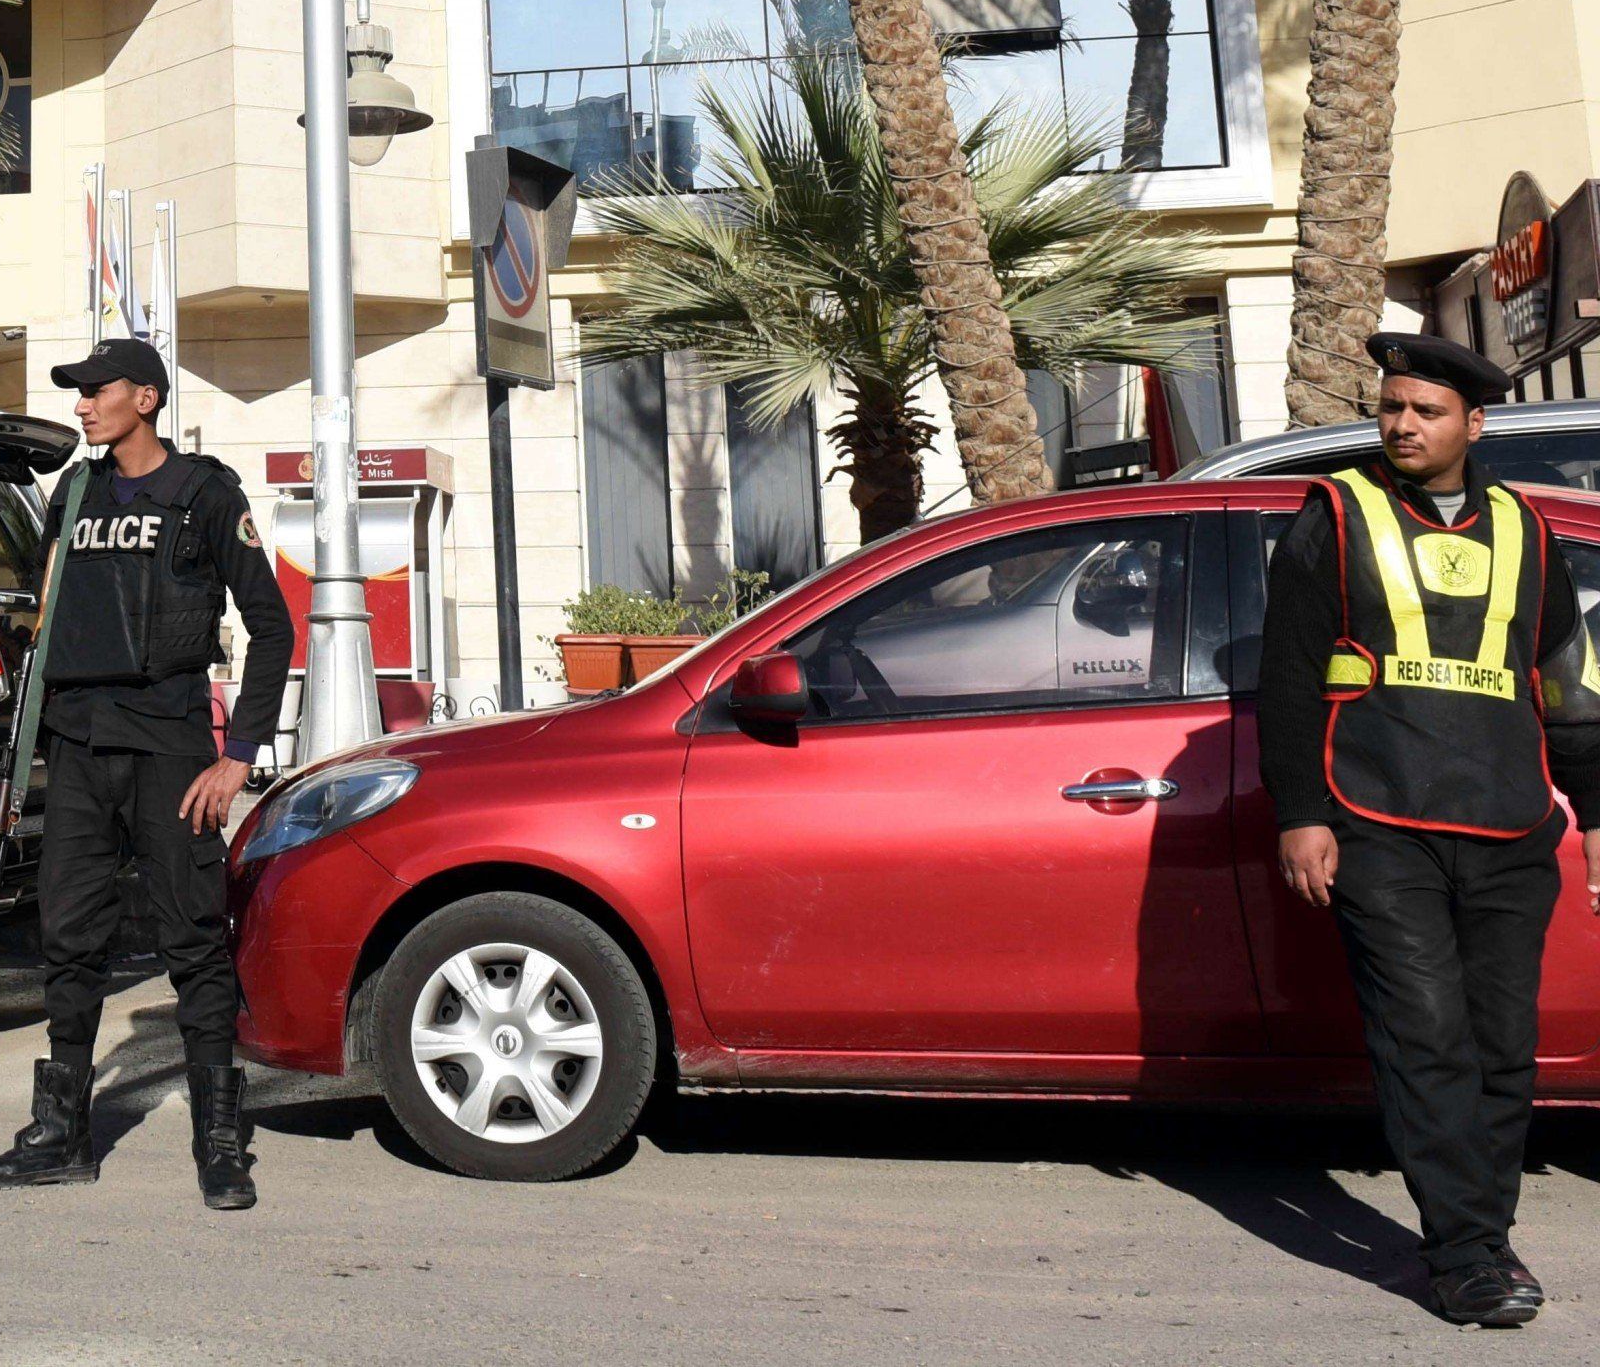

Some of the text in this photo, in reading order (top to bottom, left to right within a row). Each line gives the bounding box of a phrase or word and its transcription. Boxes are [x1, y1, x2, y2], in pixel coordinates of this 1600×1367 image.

[70, 515, 162, 550] OLICE
[1073, 658, 1144, 674] HILUX
[1397, 660, 1504, 692] RED SEA TRAFFIC
